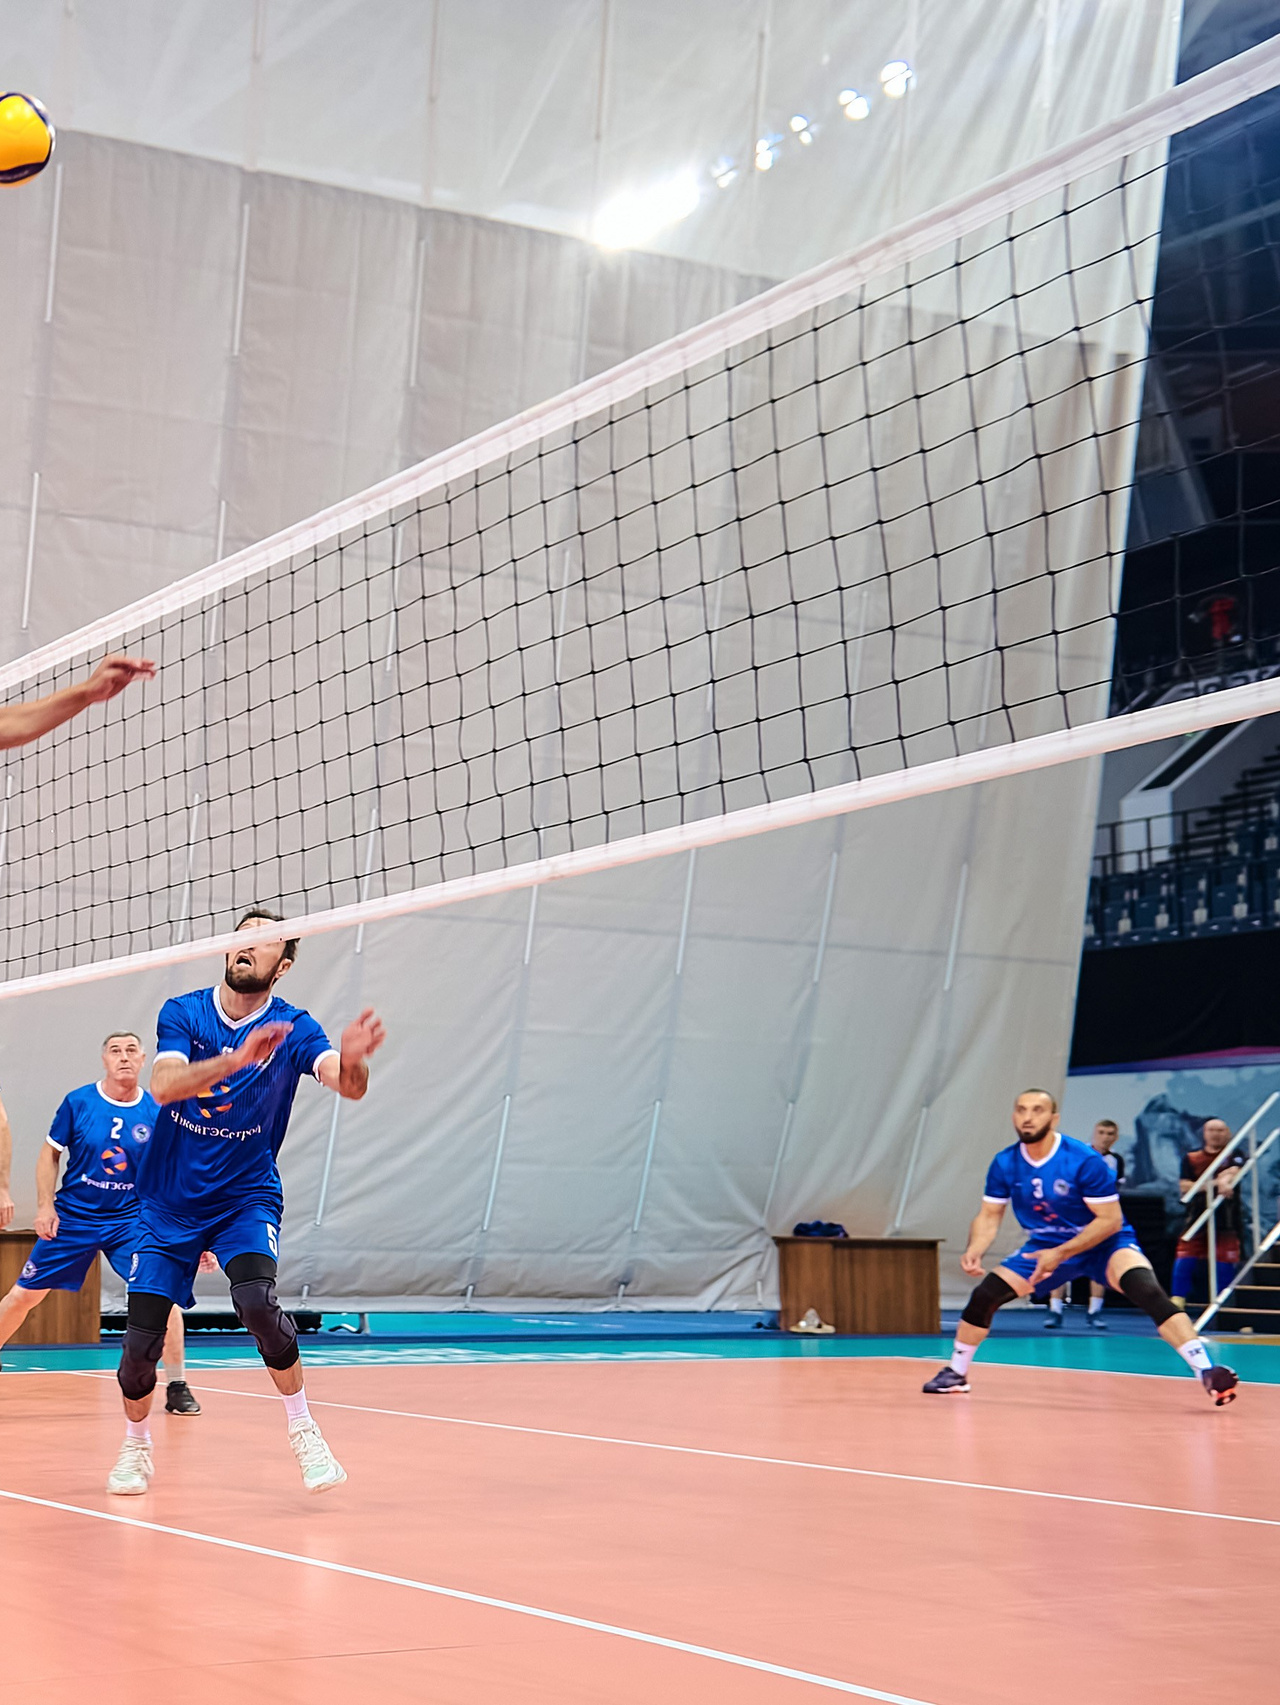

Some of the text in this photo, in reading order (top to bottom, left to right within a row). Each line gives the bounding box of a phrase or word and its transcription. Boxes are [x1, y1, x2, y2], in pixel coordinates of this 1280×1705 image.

[111, 1116, 124, 1139] 2
[1031, 1178, 1044, 1199] 3
[266, 1222, 278, 1257] 5
